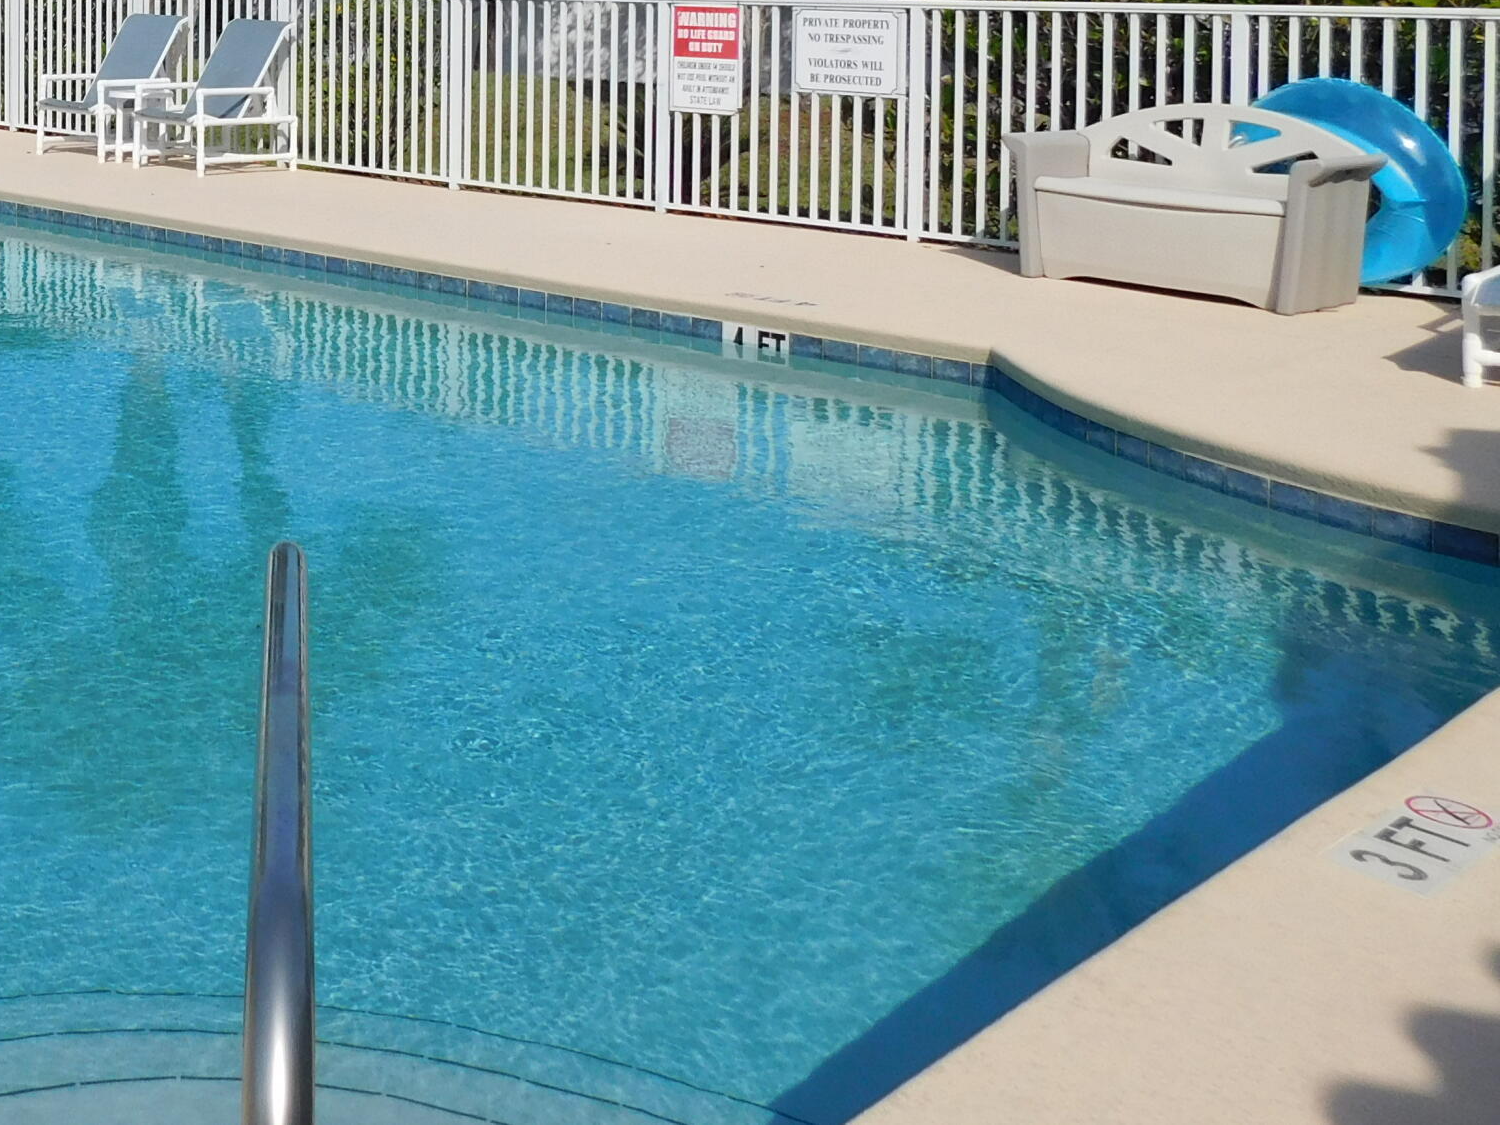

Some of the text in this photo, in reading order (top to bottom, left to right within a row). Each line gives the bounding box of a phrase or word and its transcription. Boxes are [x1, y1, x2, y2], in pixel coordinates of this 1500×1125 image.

[677, 11, 736, 28] WARNING
[802, 17, 890, 30] PRIVATE PROPERTY
[677, 28, 689, 39] NO
[690, 29, 706, 40] LIFE
[808, 32, 884, 45] NO TRESPASSING
[688, 41, 723, 53] ON DUTY
[808, 57, 884, 71] VIOLATORS WILL
[809, 73, 882, 86] BE PROSECUTED
[757, 330, 786, 352] FT
[1373, 816, 1471, 862] FT
[1350, 849, 1429, 881] 3
